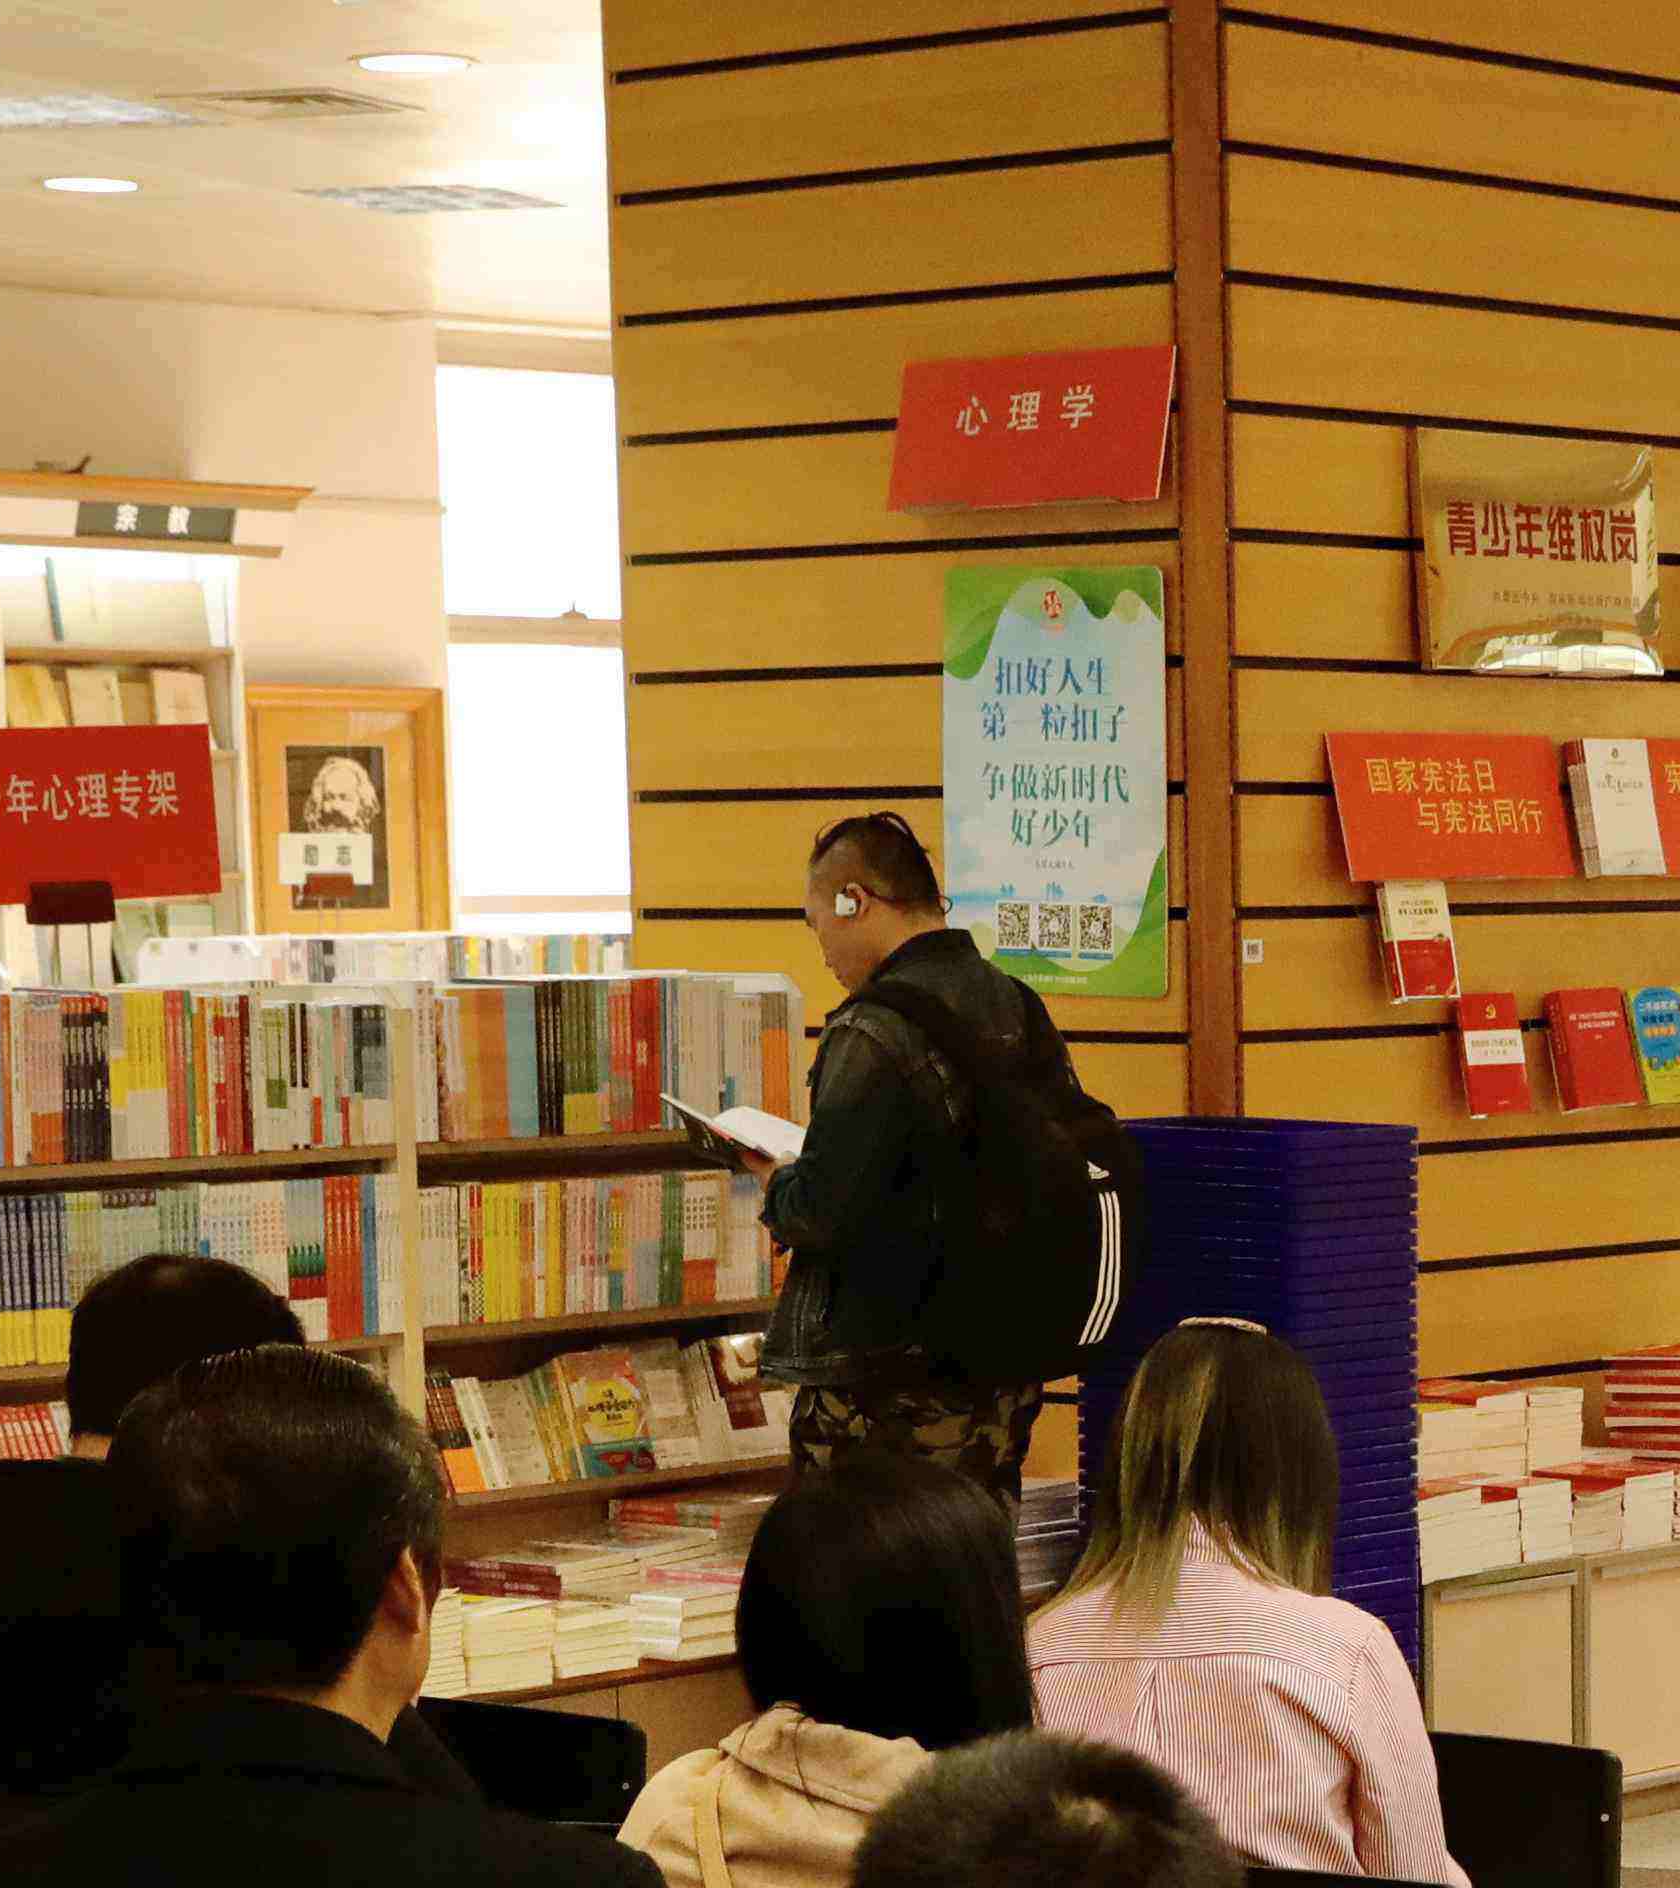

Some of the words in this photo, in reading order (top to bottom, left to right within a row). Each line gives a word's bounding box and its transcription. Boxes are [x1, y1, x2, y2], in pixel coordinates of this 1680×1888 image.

[956, 383, 1096, 437] 心理学
[1447, 500, 1638, 563] 青少年维权岗
[995, 657, 1110, 697] 扣好人生
[980, 703, 1128, 743] 第一粒扣子
[980, 762, 1130, 804] 争做新时代
[1366, 758, 1496, 794] 国家宪法日
[1010, 808, 1095, 848] 好少年
[1416, 798, 1543, 835] 与宪法同行
